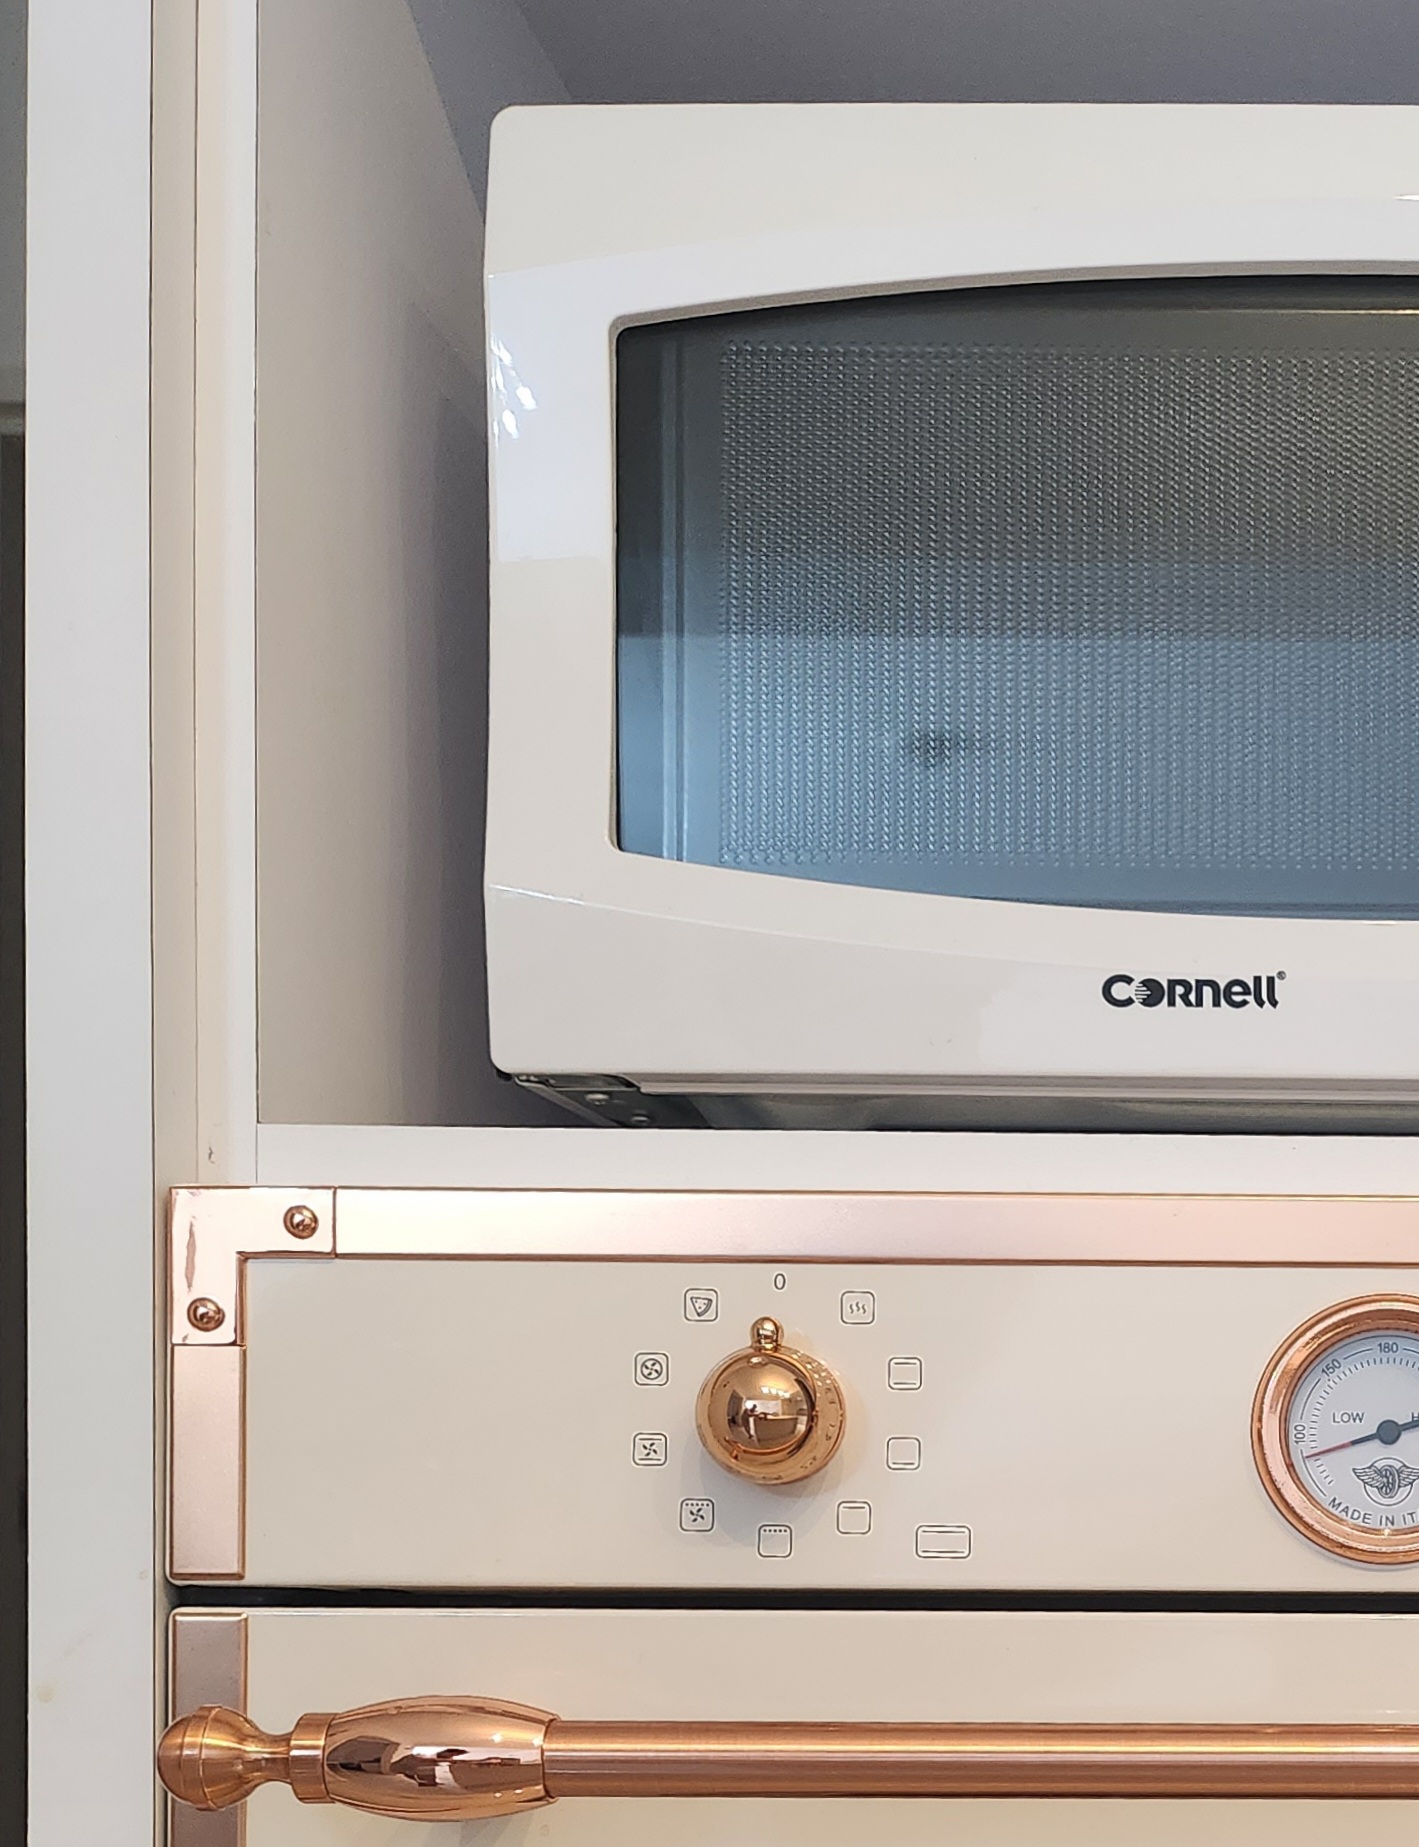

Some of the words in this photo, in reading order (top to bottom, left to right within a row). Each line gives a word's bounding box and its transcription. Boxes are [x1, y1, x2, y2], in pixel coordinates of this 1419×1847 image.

[1376, 1342, 1399, 1354] 180
[1320, 1358, 1342, 1379] 150
[1332, 1412, 1365, 1424] LOW
[1293, 1424, 1306, 1446] 100
[1328, 1497, 1372, 1525] MADE
[1379, 1515, 1395, 1527] IN
